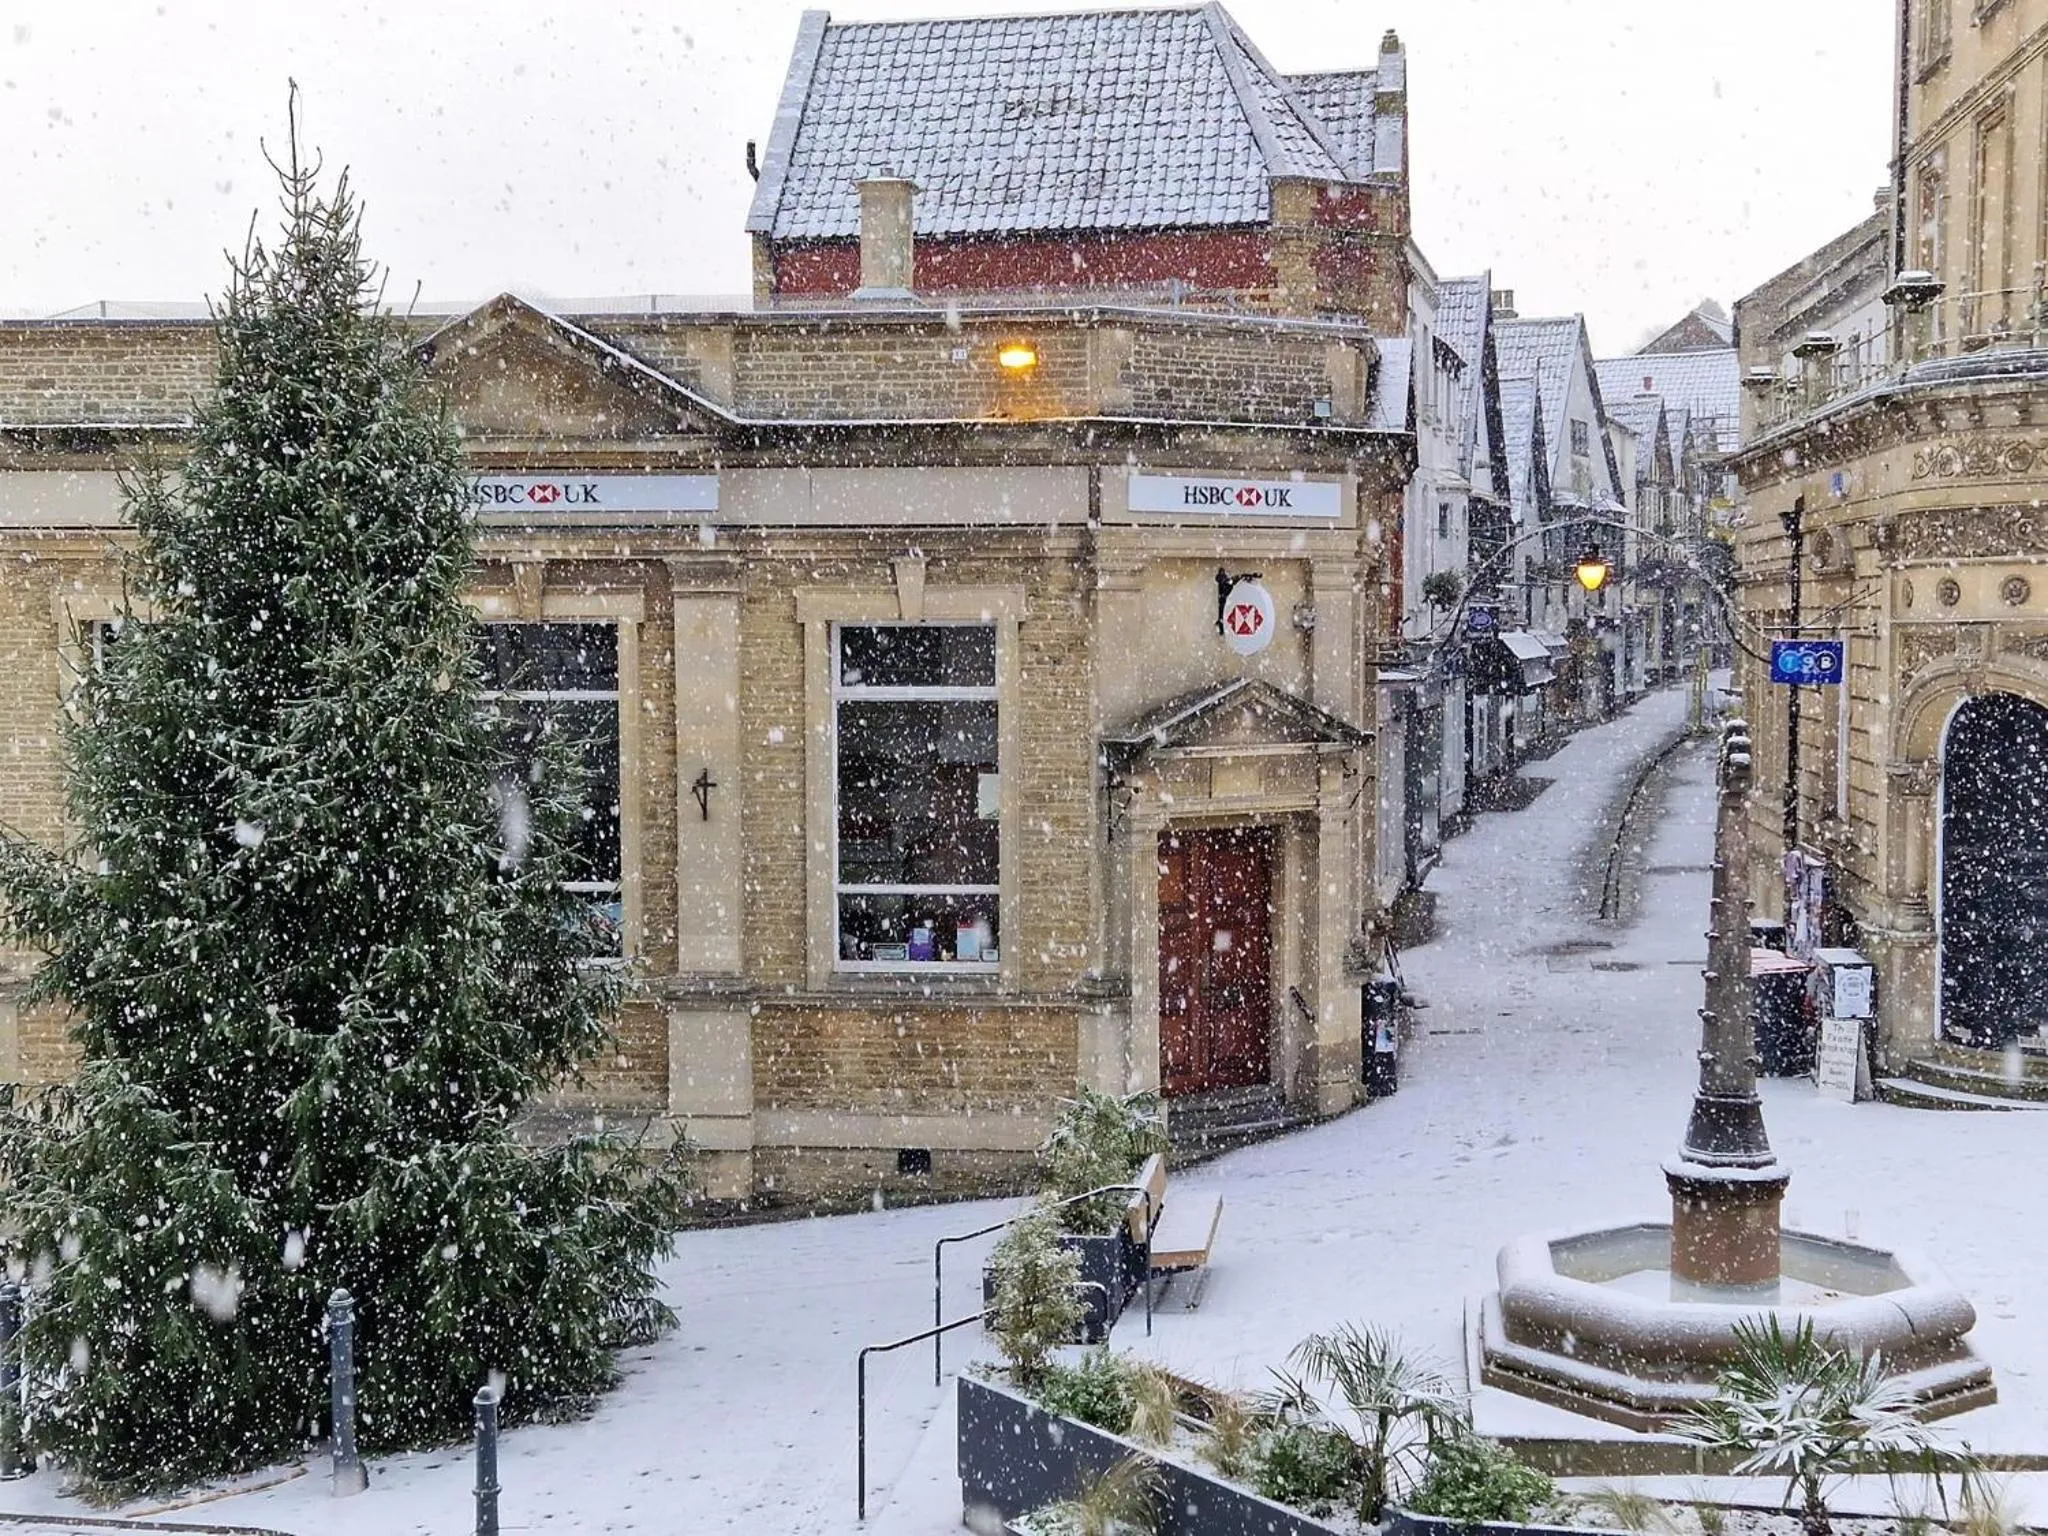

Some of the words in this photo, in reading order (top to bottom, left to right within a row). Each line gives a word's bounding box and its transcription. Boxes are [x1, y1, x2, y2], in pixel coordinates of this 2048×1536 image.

[564, 484, 601, 503] UK
[1184, 485, 1234, 506] HSBC
[1265, 488, 1293, 507] UK
